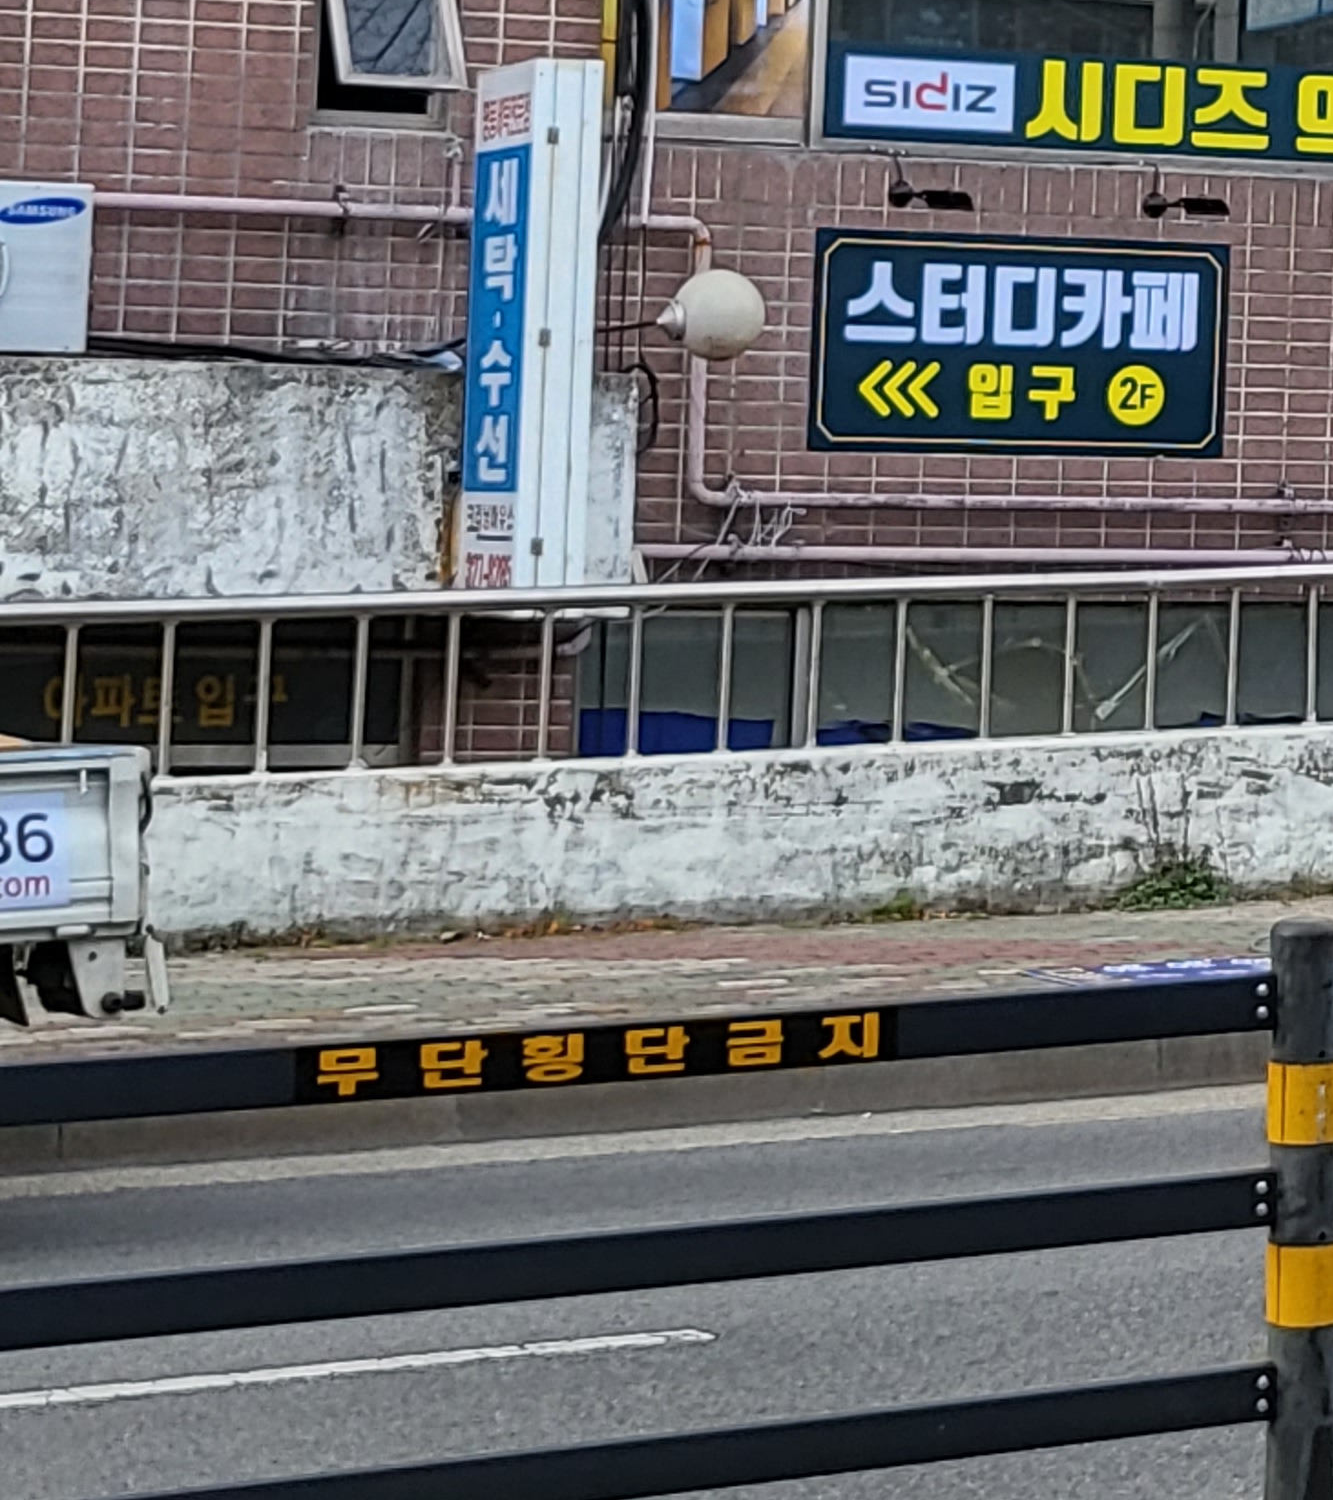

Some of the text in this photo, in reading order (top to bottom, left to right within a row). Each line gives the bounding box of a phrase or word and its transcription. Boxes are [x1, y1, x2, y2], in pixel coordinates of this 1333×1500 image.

[1025, 58, 1270, 151] 시디즈
[8, 205, 77, 217] SAMSUNG
[844, 261, 1200, 352] 스터디카페
[968, 364, 1156, 420] 입구 2F
[0, 875, 50, 898] om
